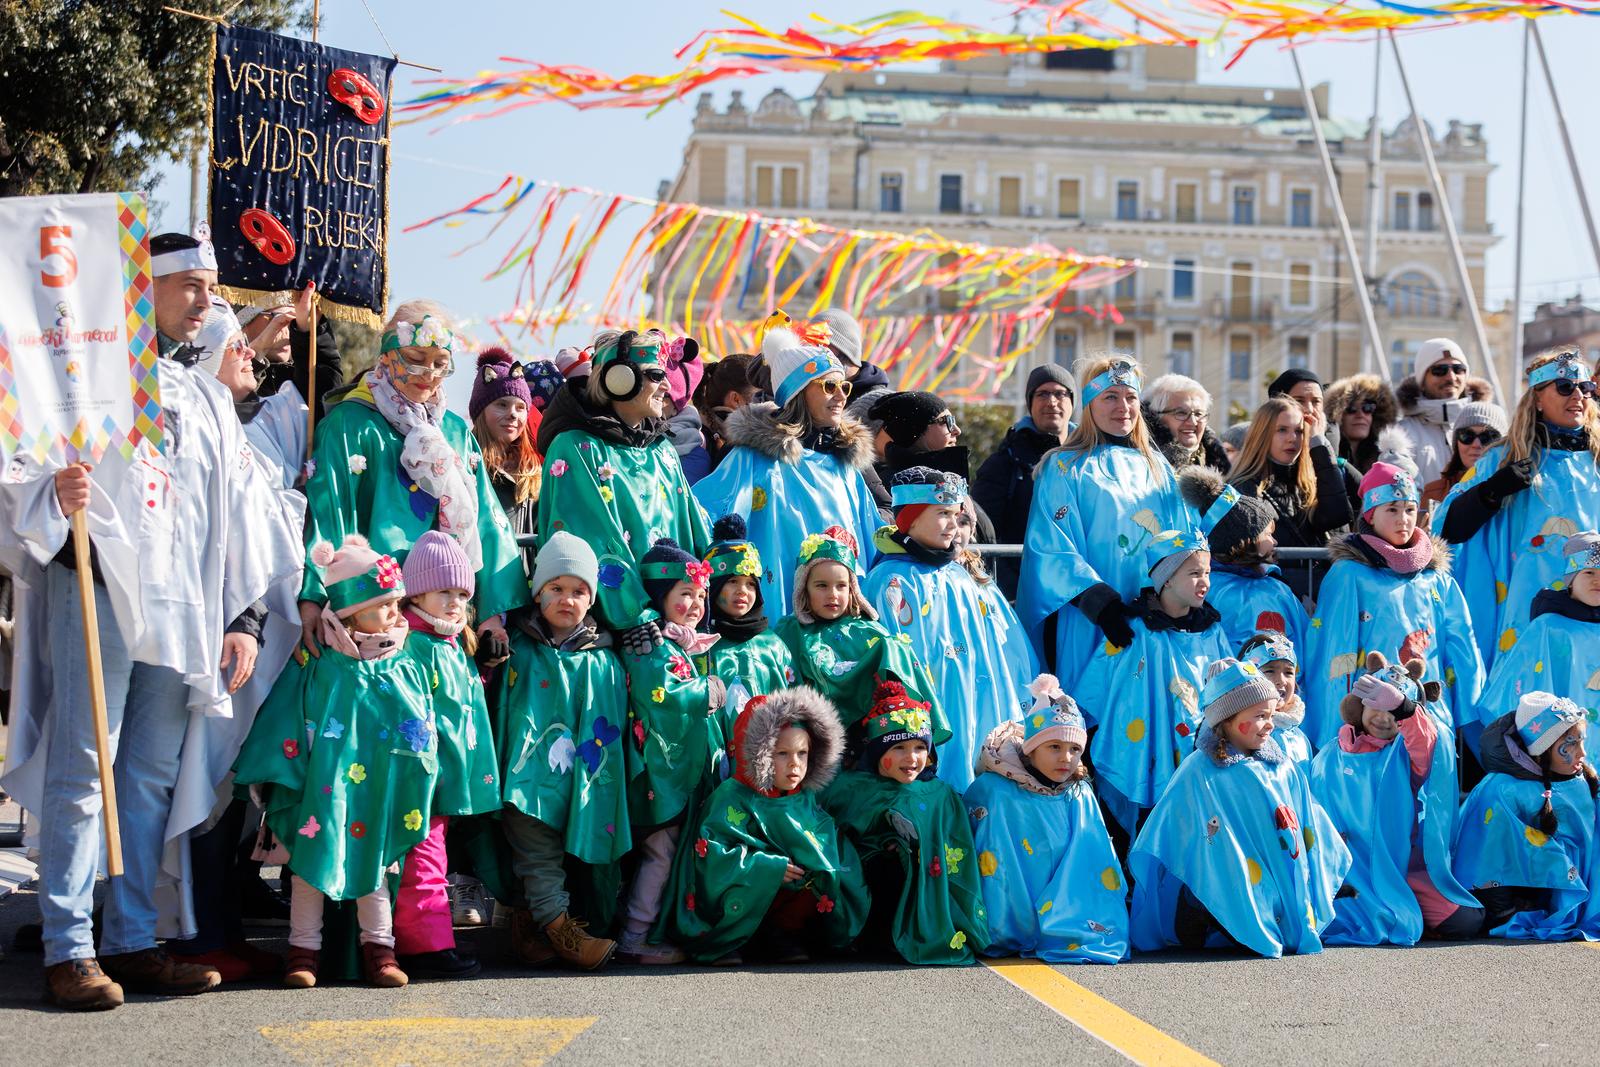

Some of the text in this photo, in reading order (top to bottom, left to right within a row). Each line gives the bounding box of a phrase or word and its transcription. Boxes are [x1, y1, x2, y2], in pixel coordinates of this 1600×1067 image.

[237, 114, 381, 189] VIDRICE
[40, 226, 78, 288] 5
[305, 206, 383, 257] RIJEKA
